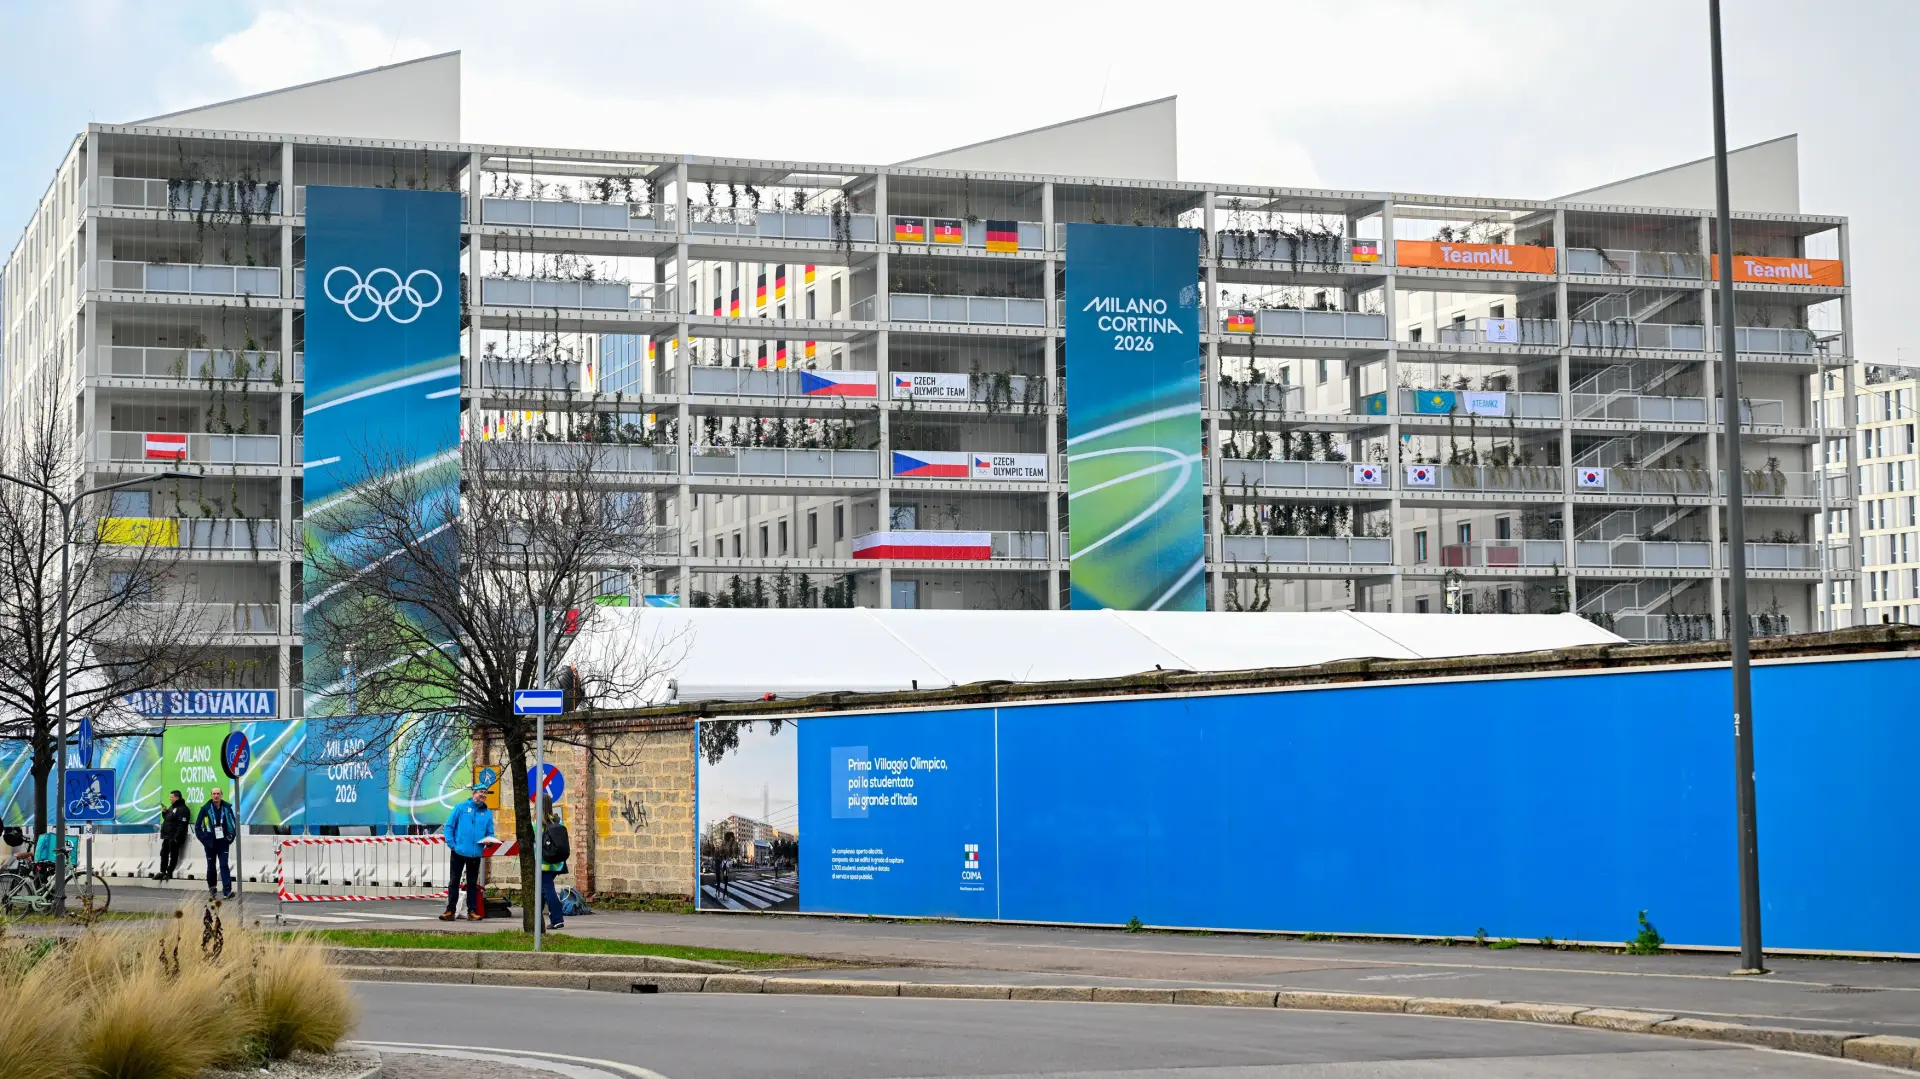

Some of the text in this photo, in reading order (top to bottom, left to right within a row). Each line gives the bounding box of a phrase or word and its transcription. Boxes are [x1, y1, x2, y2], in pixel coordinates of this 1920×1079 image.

[906, 224, 913, 233] D
[944, 225, 952, 235] D
[1440, 246, 1513, 265] TeamNL
[1744, 260, 1812, 279] TeamNL
[1082, 296, 1168, 315] MILANO
[1098, 315, 1184, 335] CORTINA
[1114, 335, 1155, 352] 2026
[914, 376, 936, 386] CZECH
[914, 387, 965, 397] OLYMPIC TEAM
[993, 456, 1015, 466] CZECH
[993, 467, 1044, 477] OLYMPIC TEAM
[170, 692, 270, 714] SLOVAKIA
[174, 745, 211, 763] MILANO
[321, 738, 365, 758] MILANO
[328, 760, 374, 780] CORTINA
[848, 756, 948, 774] Prima Villaggio Olimpico,
[180, 766, 217, 784] CORTINA
[848, 775, 914, 791] poi lo studentato
[186, 787, 204, 804] 2026
[335, 784, 357, 803] 2026
[848, 793, 861, 809] più
[861, 793, 889, 810] grande
[961, 871, 982, 880] COIMA
